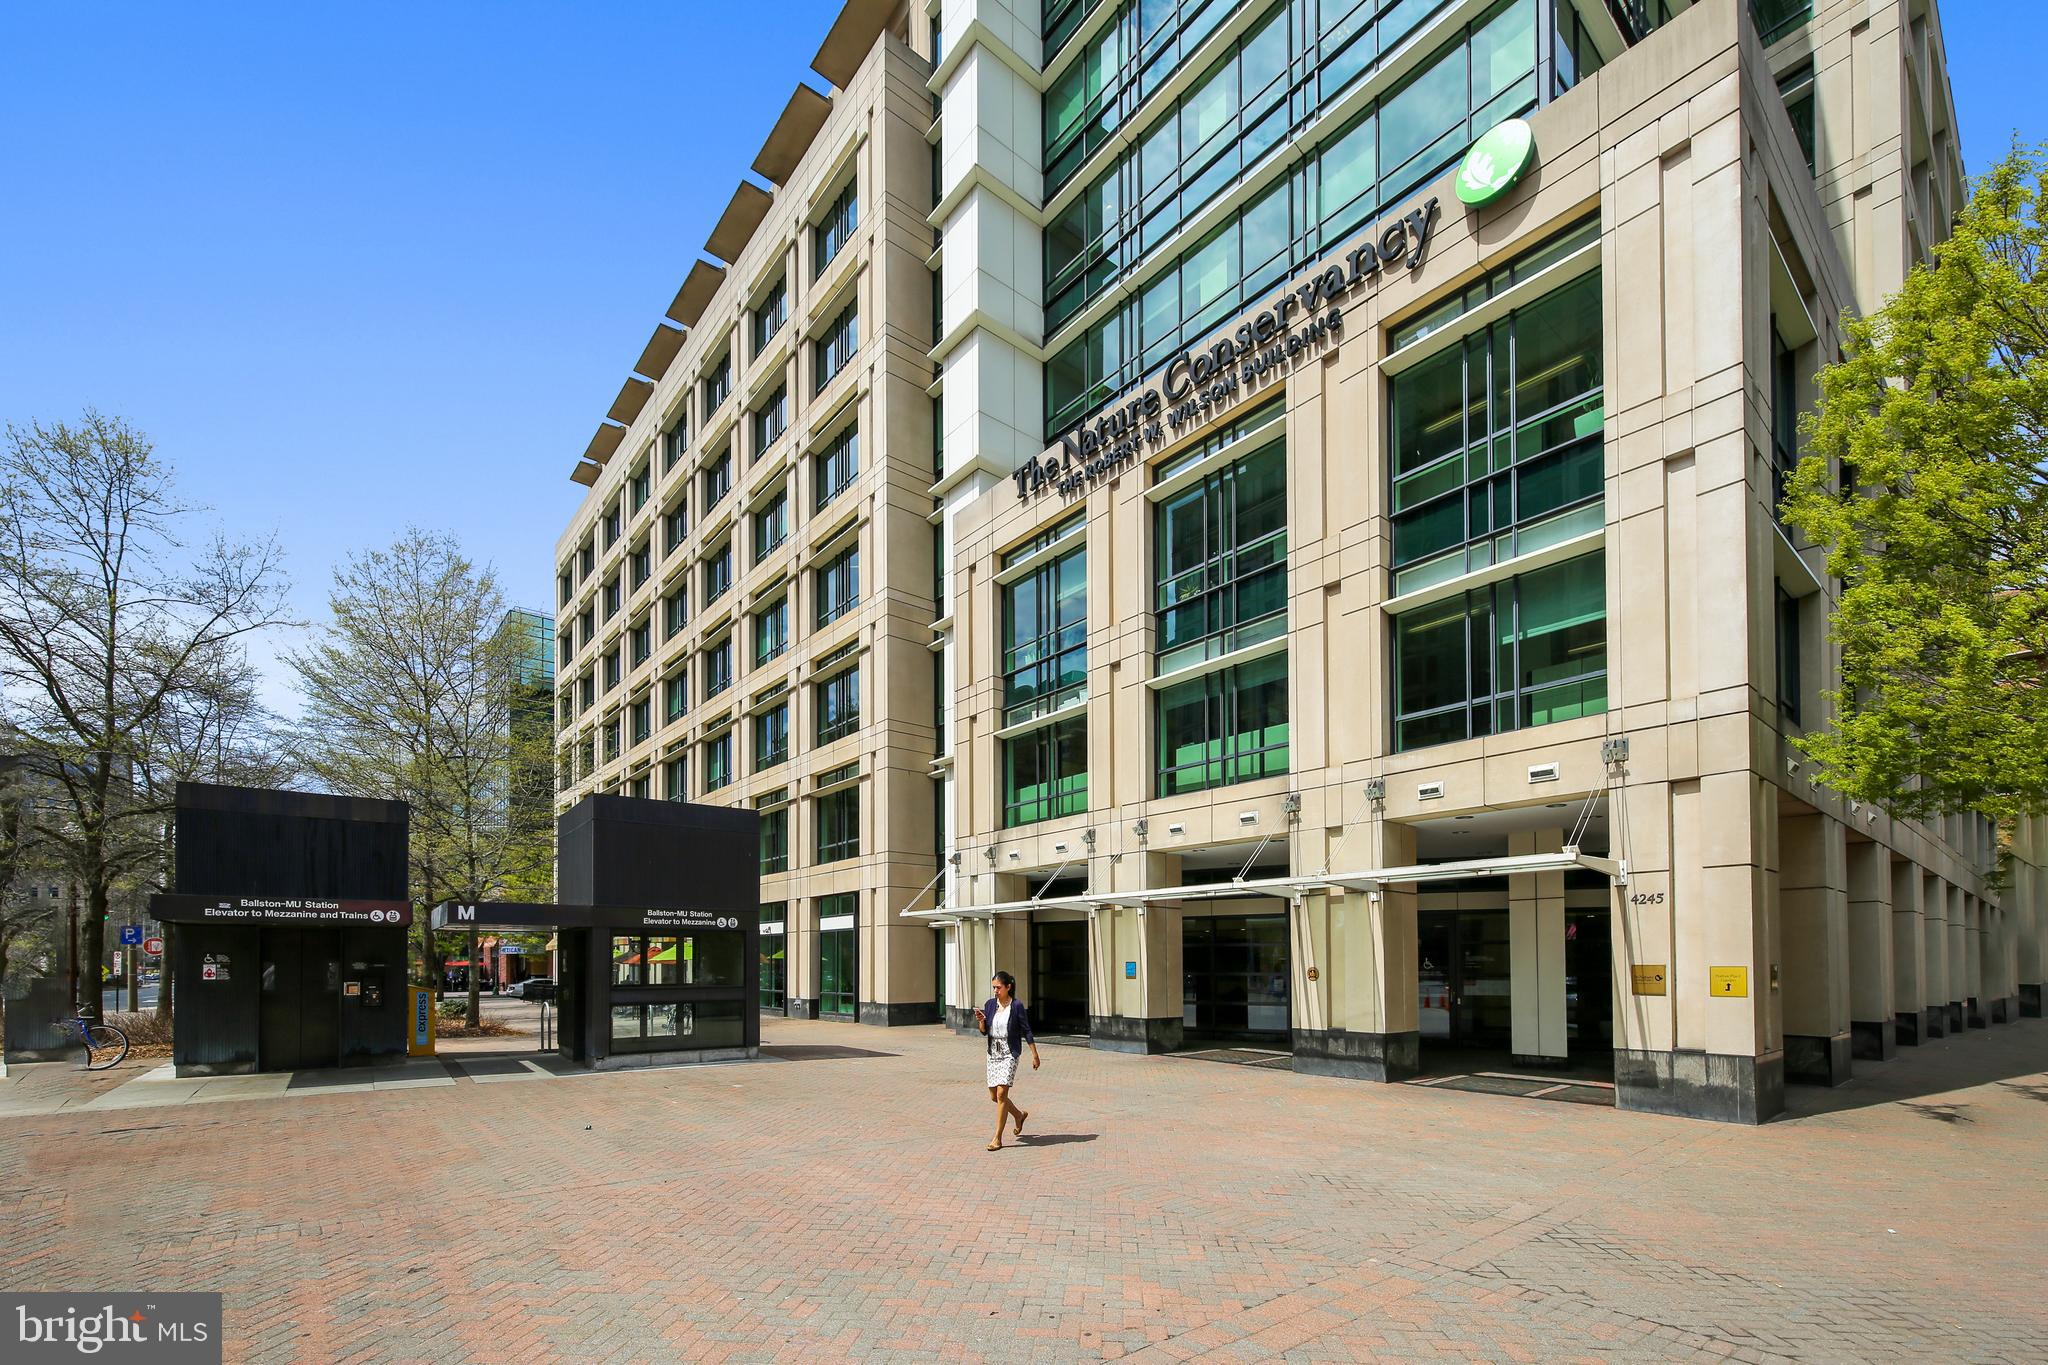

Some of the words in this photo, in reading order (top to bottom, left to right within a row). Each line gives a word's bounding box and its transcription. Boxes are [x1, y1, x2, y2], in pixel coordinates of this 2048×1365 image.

[1013, 455, 1061, 499] The
[1059, 388, 1161, 472] Nature
[1162, 196, 1439, 401] Conservancy
[1056, 470, 1084, 497] THE
[1084, 433, 1141, 482] ROBERT
[1143, 420, 1164, 444] W.
[1166, 372, 1238, 431] WILSON
[1241, 306, 1343, 385] BUILDING
[240, 899, 301, 909] Ballston-MU
[304, 901, 339, 910] Station
[1630, 892, 1665, 905] 4245
[204, 908, 249, 918] Elevator
[250, 908, 262, 918] to
[264, 909, 318, 919] Mezzanine
[319, 909, 338, 919] and
[339, 911, 369, 921] Trains
[457, 905, 475, 920] M
[647, 909, 688, 918] Ballston-MU
[689, 910, 713, 919] Station
[643, 917, 672, 925] Elevator
[673, 917, 681, 926] to
[681, 918, 716, 927] Mezzanine
[125, 928, 135, 939] P
[418, 993, 428, 1033] express
